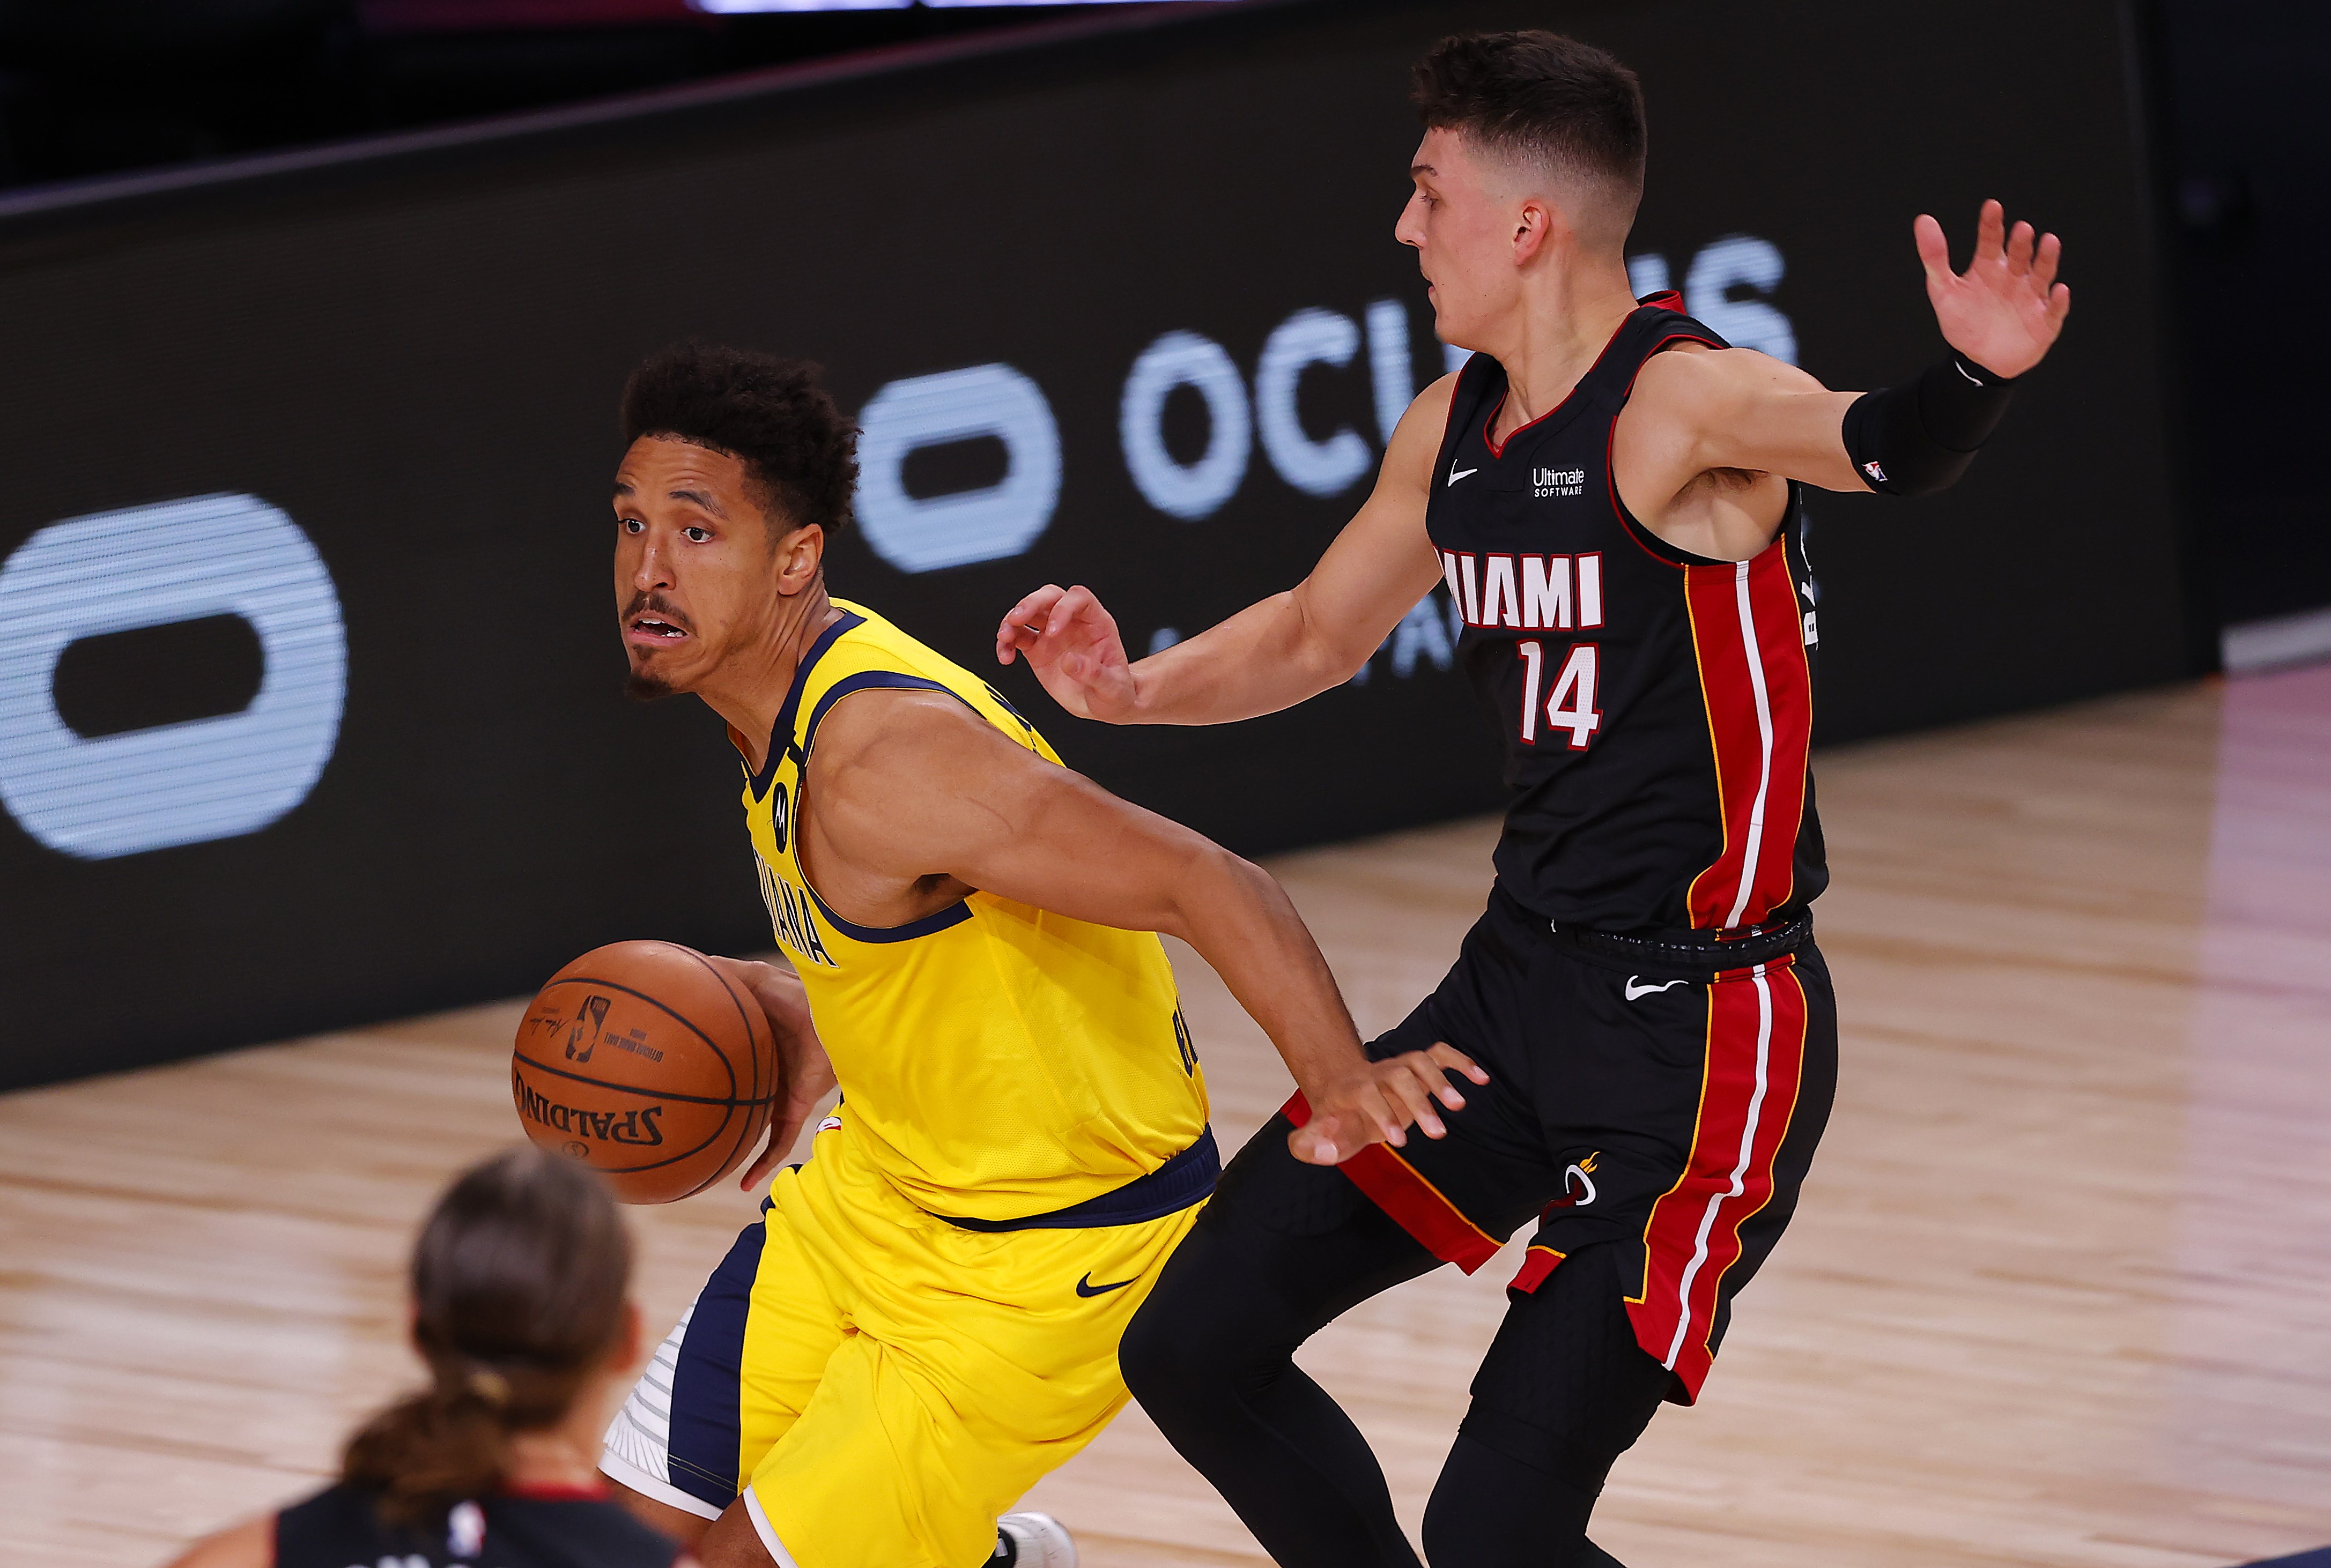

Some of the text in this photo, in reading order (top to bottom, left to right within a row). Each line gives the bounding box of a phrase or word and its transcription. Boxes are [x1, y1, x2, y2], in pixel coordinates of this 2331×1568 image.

[1533, 467, 1585, 486] Ultimate
[1534, 485, 1582, 497] SOFTWARE
[1515, 638, 1604, 752] 14
[752, 843, 840, 969] IANA
[515, 1068, 663, 1146] SPALDING
